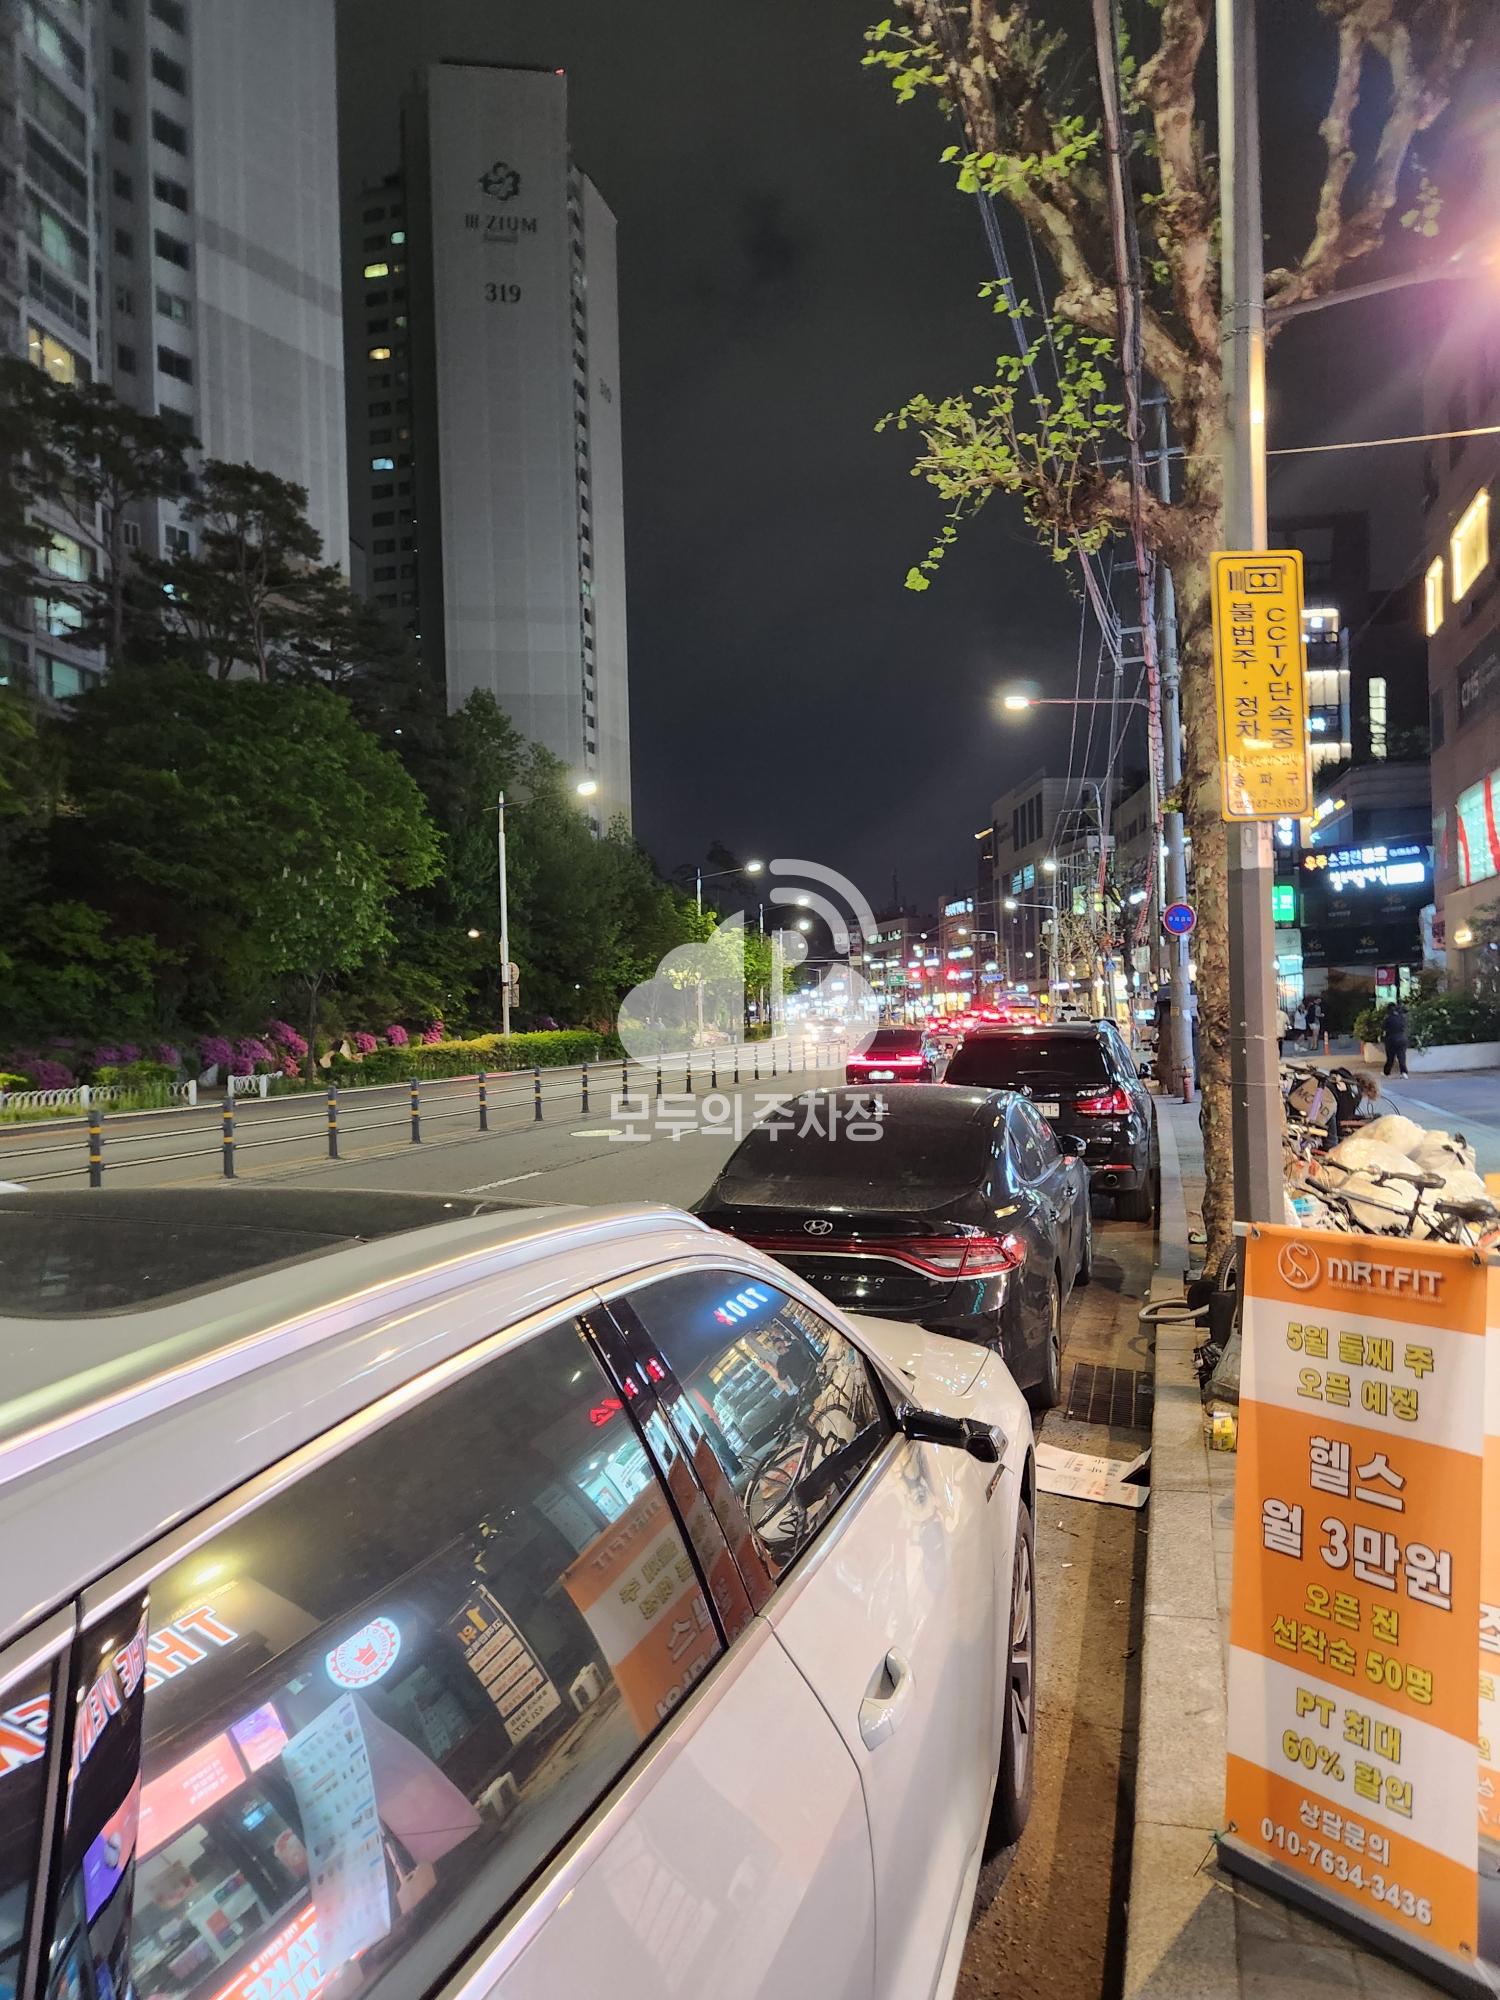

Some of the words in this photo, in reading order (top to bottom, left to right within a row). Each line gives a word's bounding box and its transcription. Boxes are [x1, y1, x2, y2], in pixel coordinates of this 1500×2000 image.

[484, 282, 522, 303] 319
[1266, 607, 1295, 750] CCTV단속중
[1326, 1256, 1443, 1296] MRTFIT
[1287, 1321, 1329, 1359] 5월
[1338, 1331, 1394, 1373] 둘째
[1404, 1342, 1434, 1379] 주
[1297, 1367, 1352, 1408] 오픈
[1361, 1379, 1419, 1422] 예정
[1309, 1435, 1405, 1513] 헬스
[1262, 1497, 1303, 1559] 월
[1319, 1516, 1453, 1612] 3만원
[1304, 1582, 1361, 1630] 오픈
[1371, 1602, 1400, 1646] 전
[1271, 1614, 1357, 1677] 선착순
[1365, 1649, 1434, 1705] 50명
[1295, 1686, 1336, 1729] PT
[1343, 1708, 1402, 1764] 최대
[1282, 1728, 1345, 1783] 60%
[1354, 1759, 1414, 1820] 할인
[1260, 1816, 1433, 1926] 010-7634-3436
[1300, 1799, 1391, 1868] 상담문의
